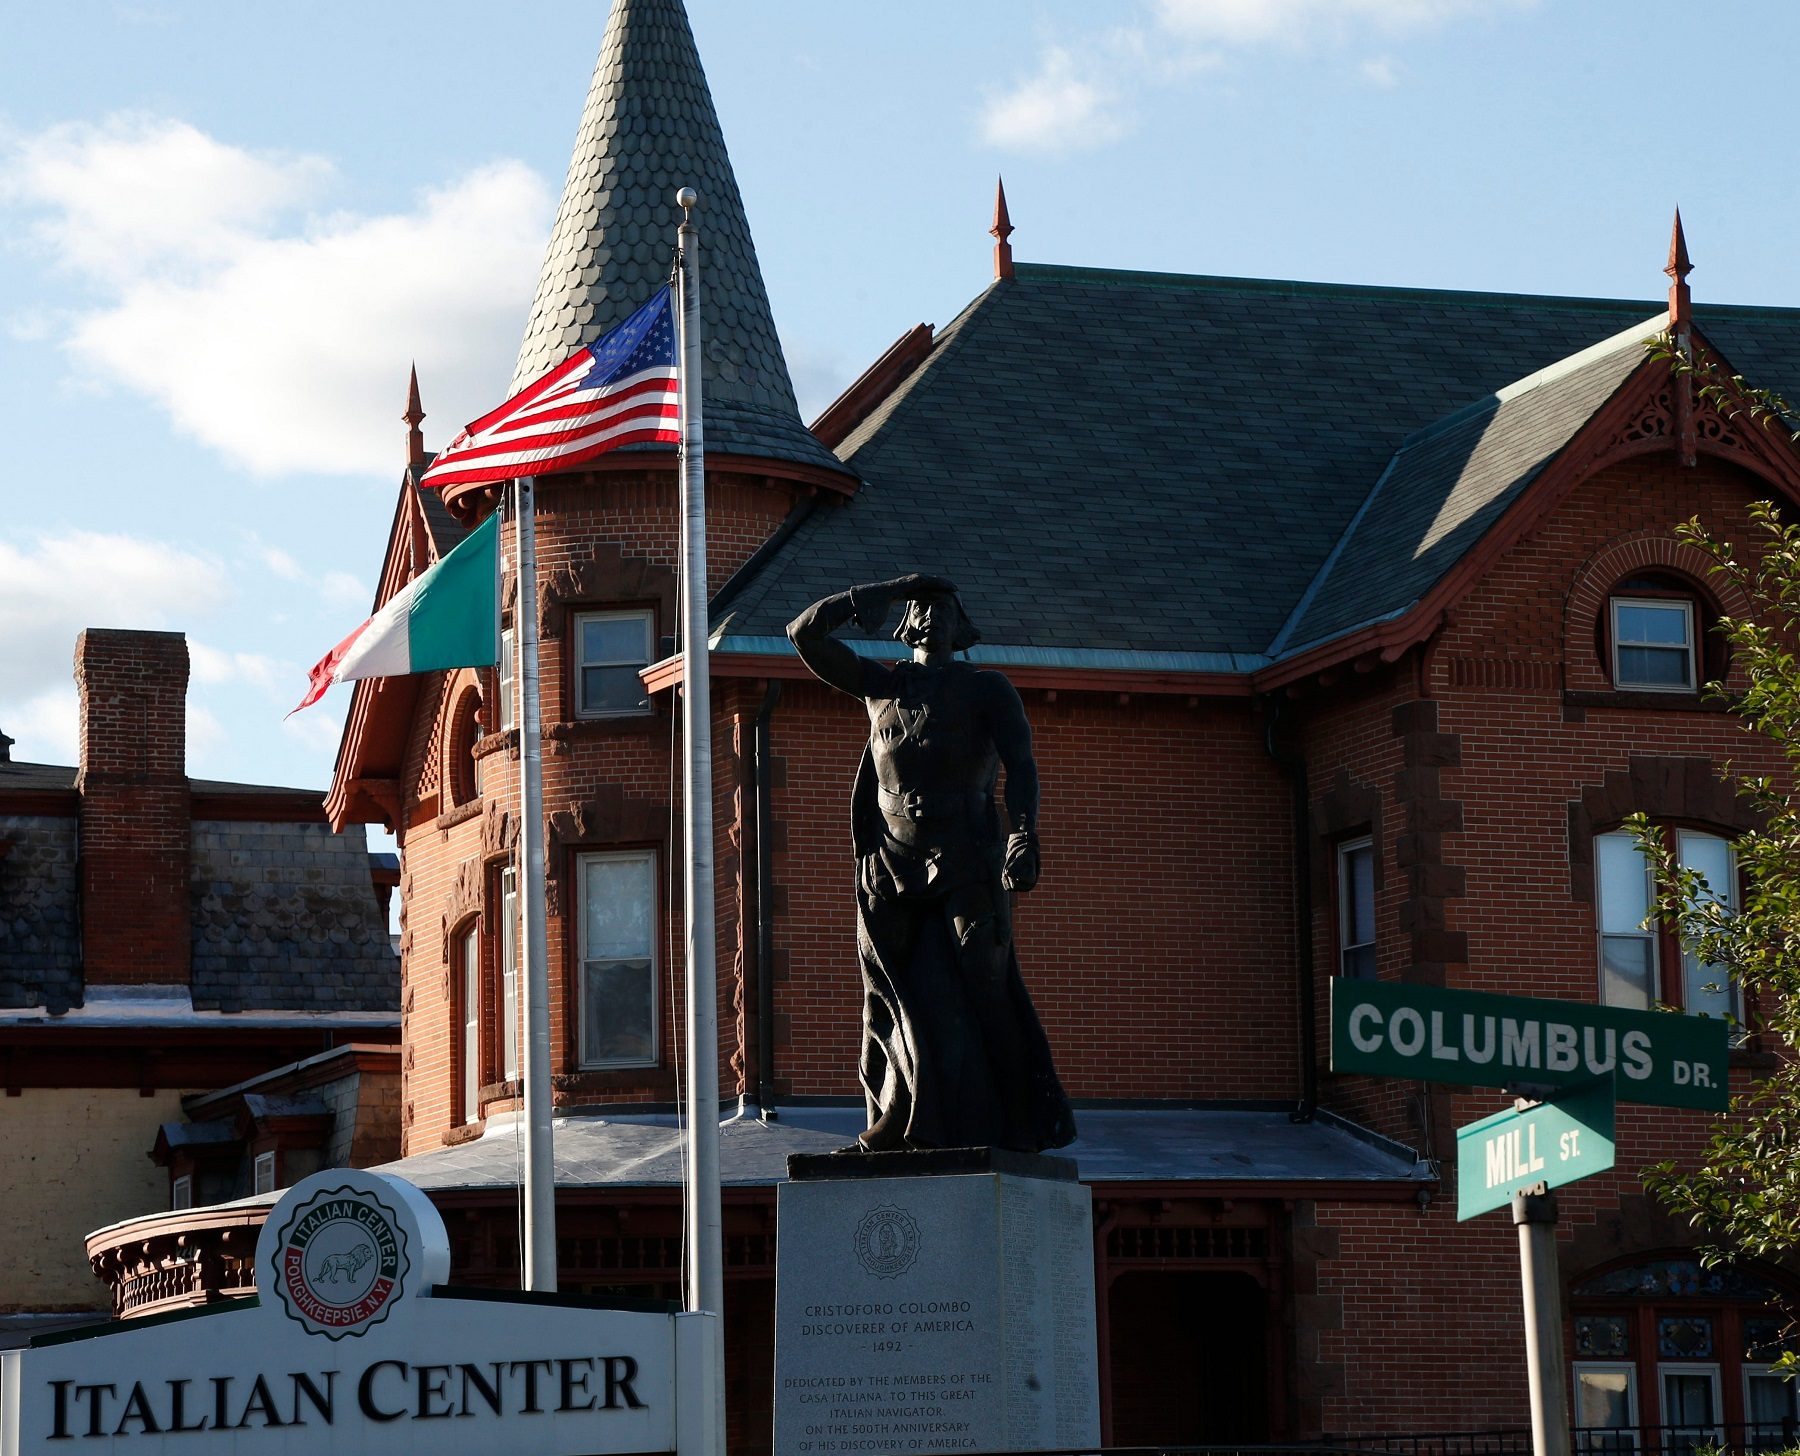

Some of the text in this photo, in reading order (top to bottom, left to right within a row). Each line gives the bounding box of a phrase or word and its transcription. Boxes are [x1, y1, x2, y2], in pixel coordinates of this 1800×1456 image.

[1348, 1003, 1718, 1088] COLUMBUS DR.
[1486, 1123, 1580, 1189] MILL ST.
[295, 1201, 396, 1268] ITALIAN CENTER
[805, 1301, 971, 1317] CRISTOFORO COLOMBO
[802, 1320, 975, 1336] DISCOVERER OF AMERICA
[784, 1374, 992, 1388] DEDICATED BY THE MEMBERS OF THE
[46, 1355, 649, 1440] ITALIAN CENTER
[799, 1394, 828, 1403] CASA
[890, 1391, 906, 1401] TO
[911, 1391, 936, 1400] THIS
[940, 1390, 976, 1400] GREAT
[830, 1409, 872, 1418] ITALIAN
[805, 1422, 970, 1435] ON THE 500TH ANNIVERSARY
[799, 1438, 977, 1451] OF HIS DISCOVERY OF AMERICA
